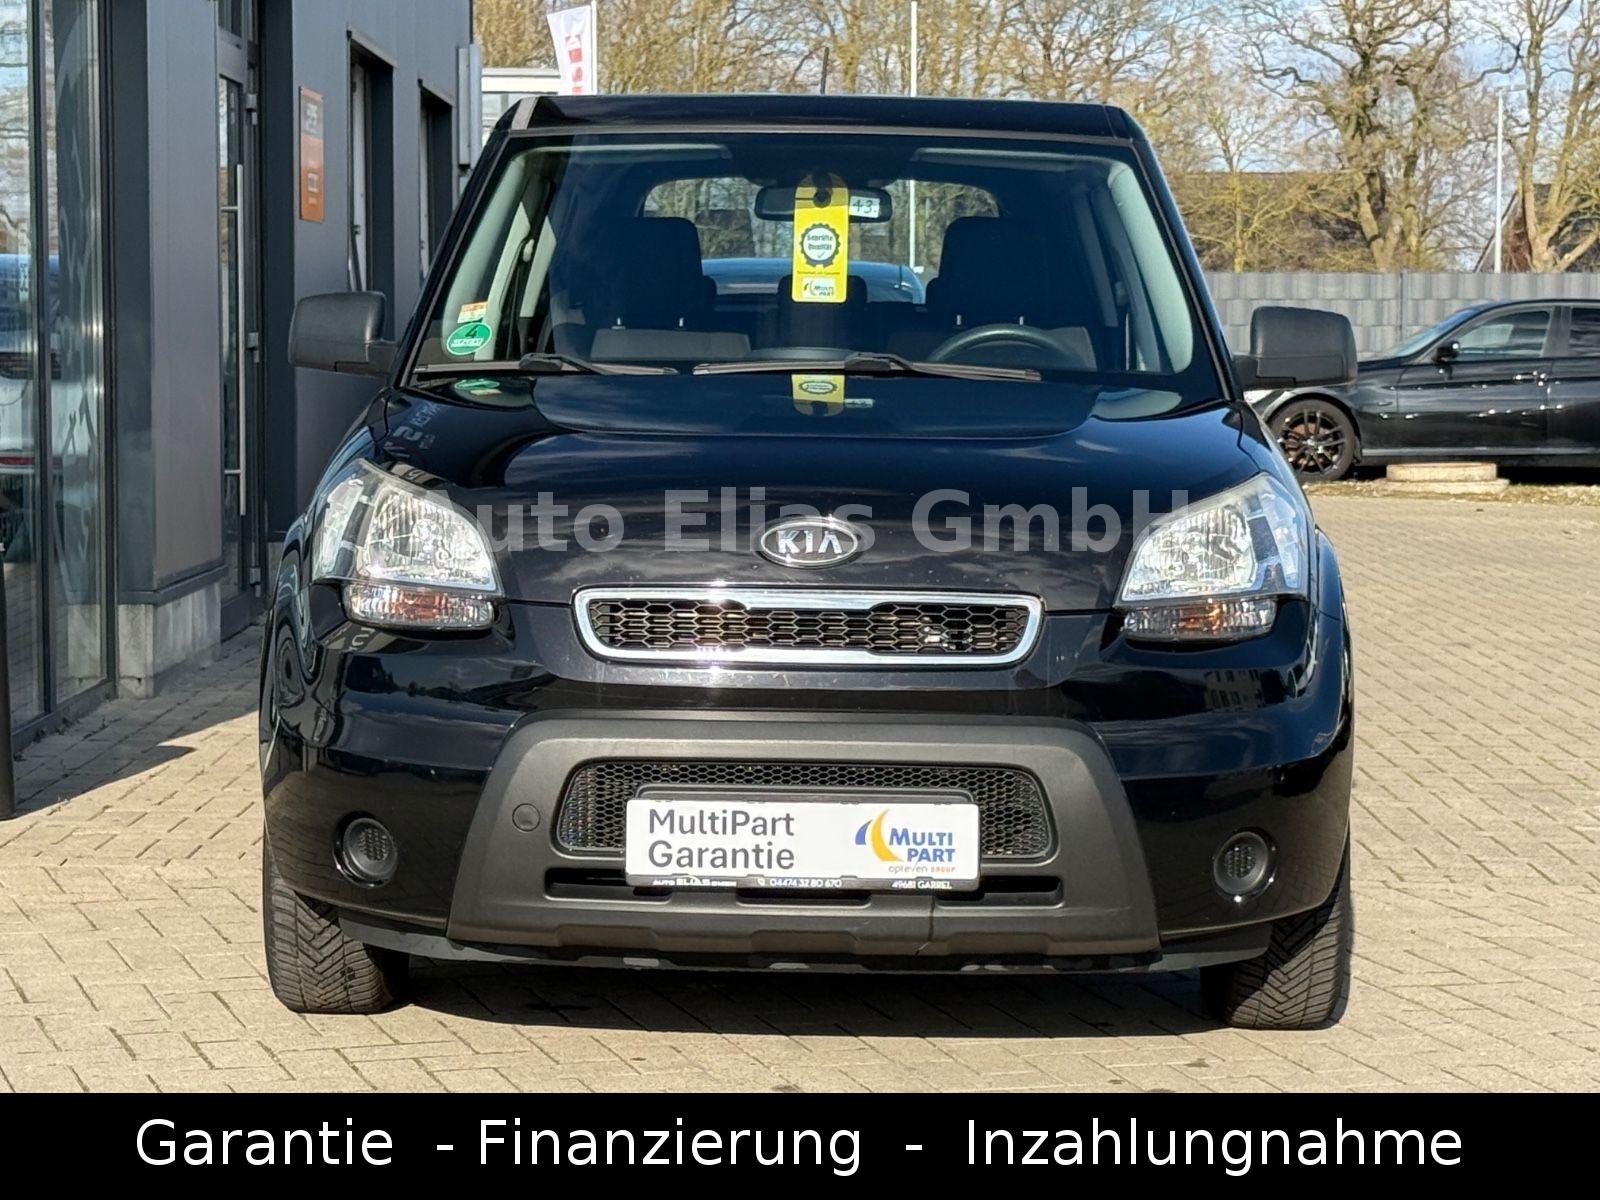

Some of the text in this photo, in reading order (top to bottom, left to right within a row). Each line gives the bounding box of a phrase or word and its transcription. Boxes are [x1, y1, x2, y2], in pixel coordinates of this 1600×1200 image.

[464, 324, 480, 339] 4
[776, 530, 843, 554] KIA
[649, 808, 795, 837] MultiPart
[648, 840, 795, 870] Garantie
[907, 848, 956, 863] PART
[888, 863, 928, 874] opteven
[676, 878, 711, 887] ELIAS
[769, 879, 798, 888] 04474
[824, 880, 843, 888] 670
[917, 880, 953, 890] GARREL
